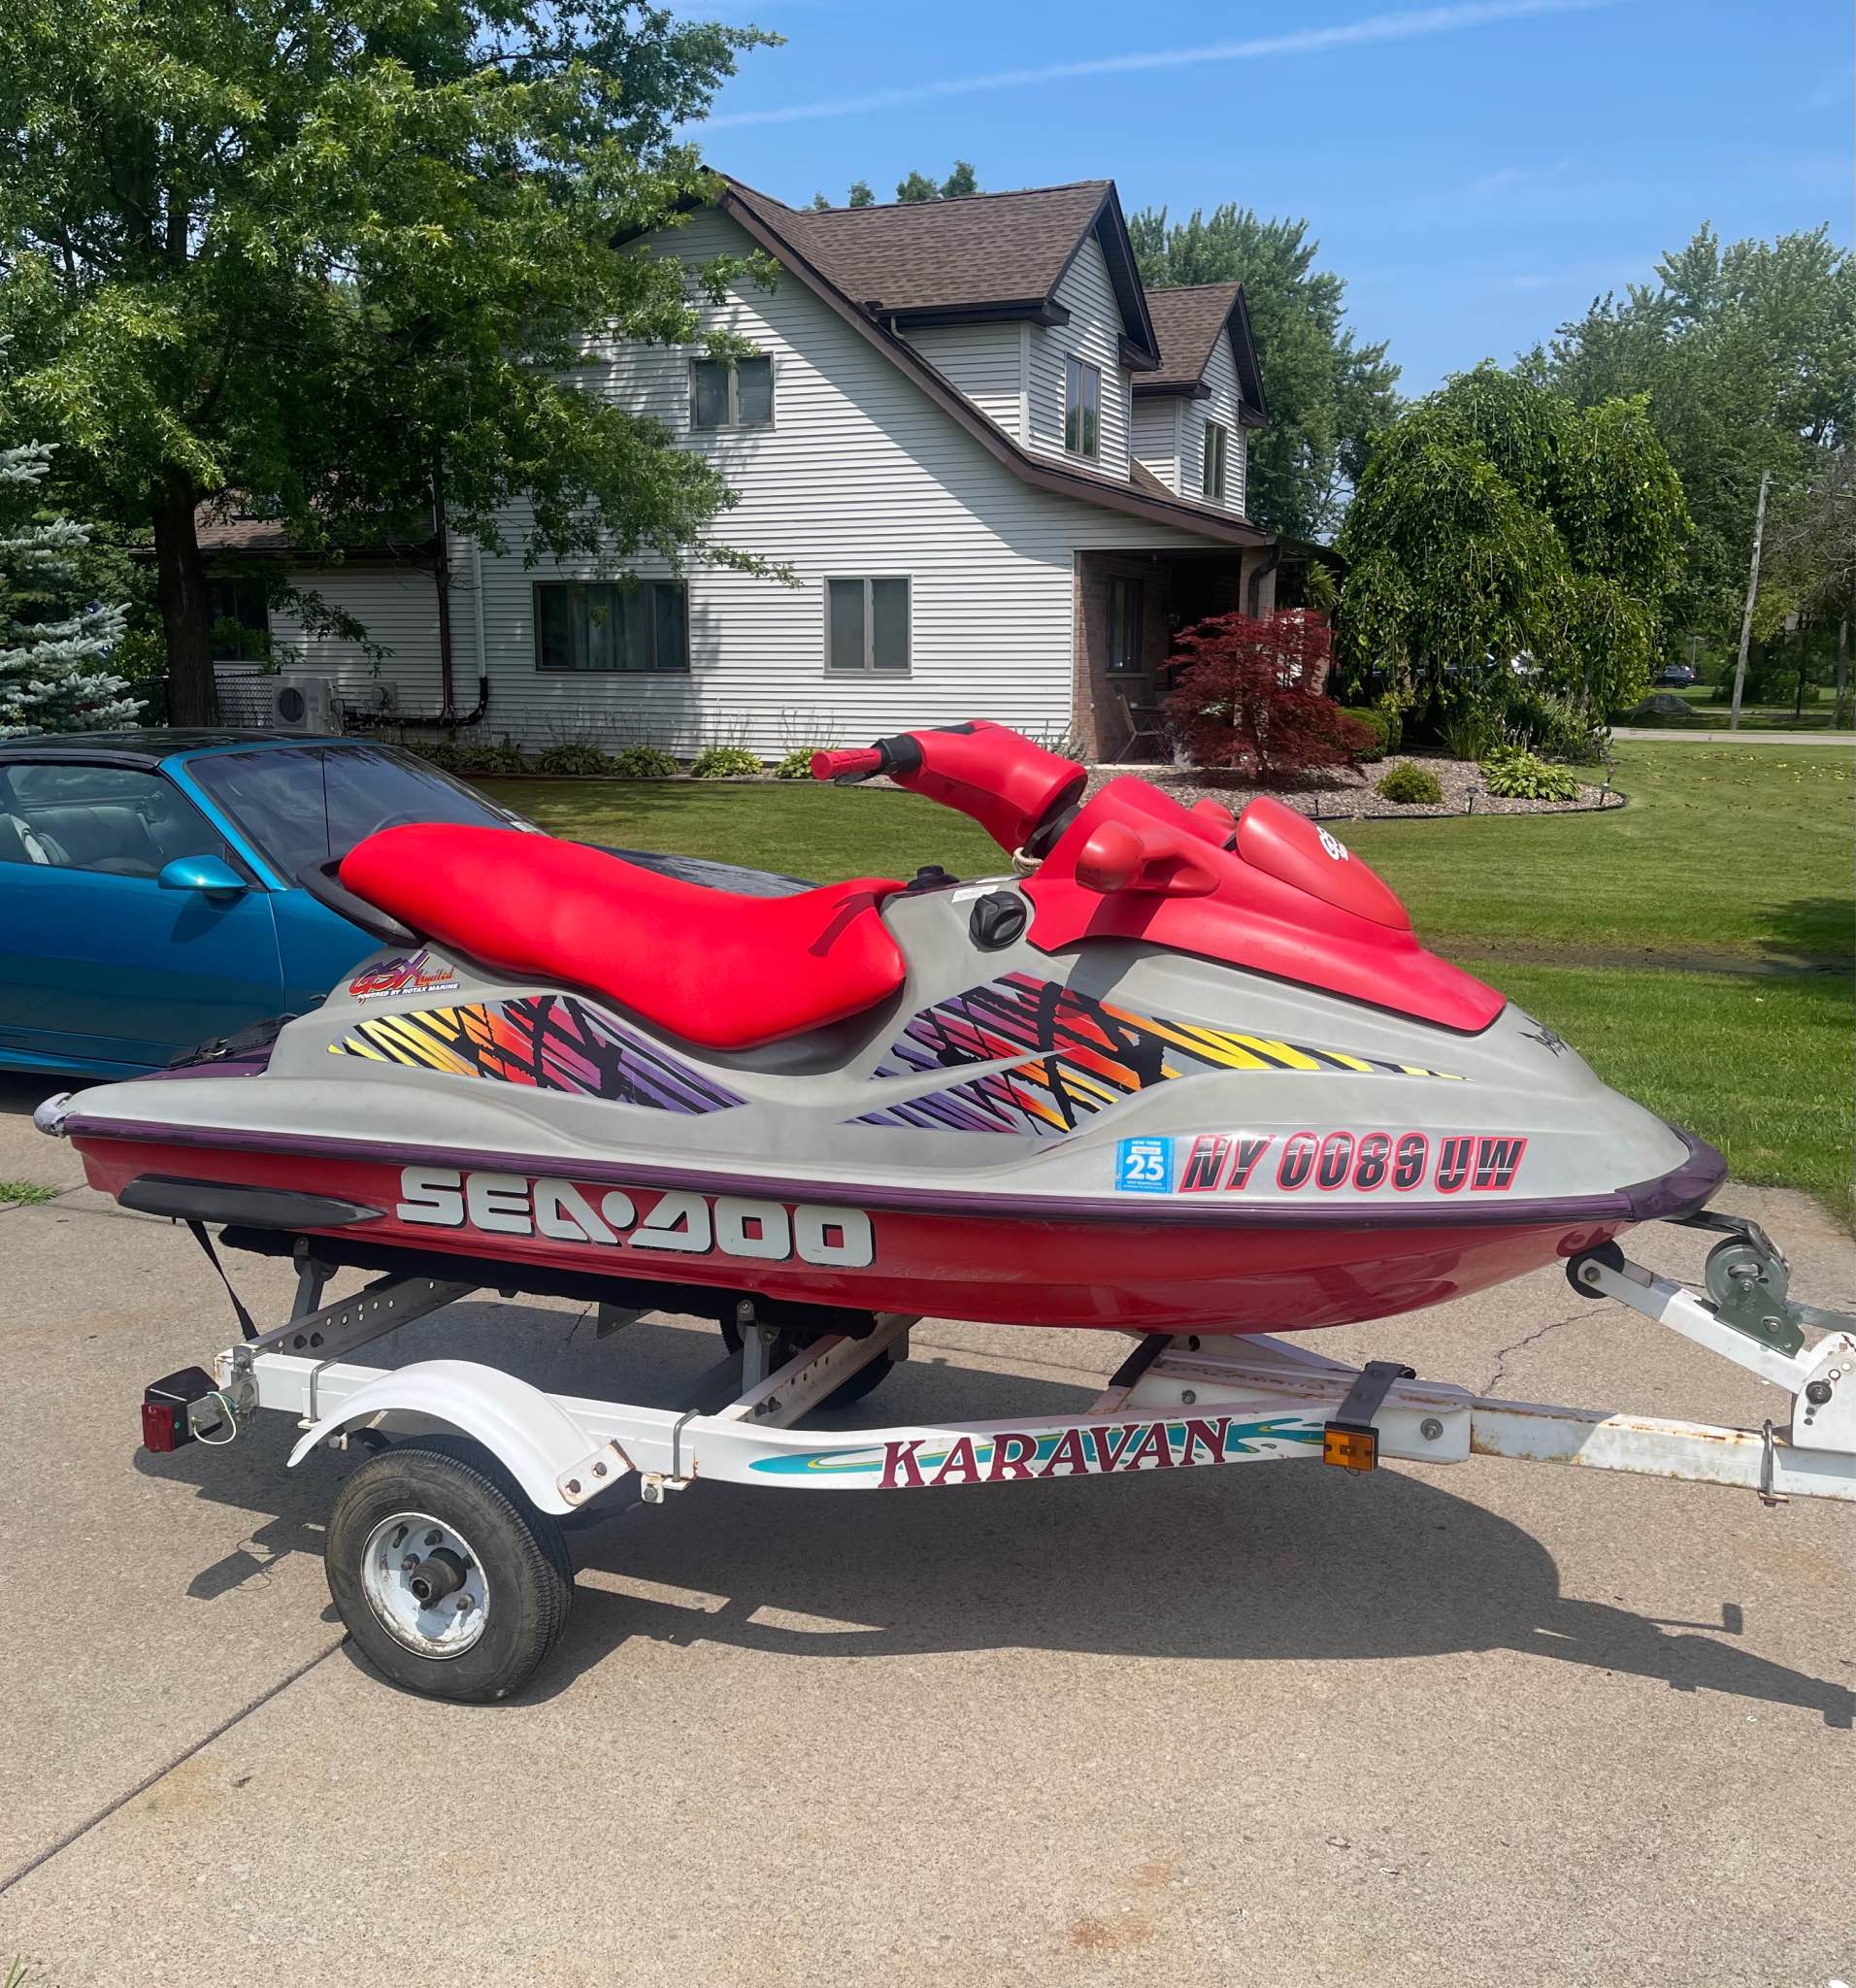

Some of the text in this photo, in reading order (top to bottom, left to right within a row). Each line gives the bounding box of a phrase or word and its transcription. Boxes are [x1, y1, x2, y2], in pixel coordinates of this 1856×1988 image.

[348, 949, 430, 1006] GSX
[356, 990, 390, 1001] POWERED
[402, 985, 427, 995] ROTAX
[427, 982, 459, 992] MARINE
[417, 964, 457, 986] Limited
[1125, 1154, 1165, 1181] 25
[1177, 1130, 1529, 1194] NY 0089 UW
[878, 1417, 1233, 1489] KARAVAN
